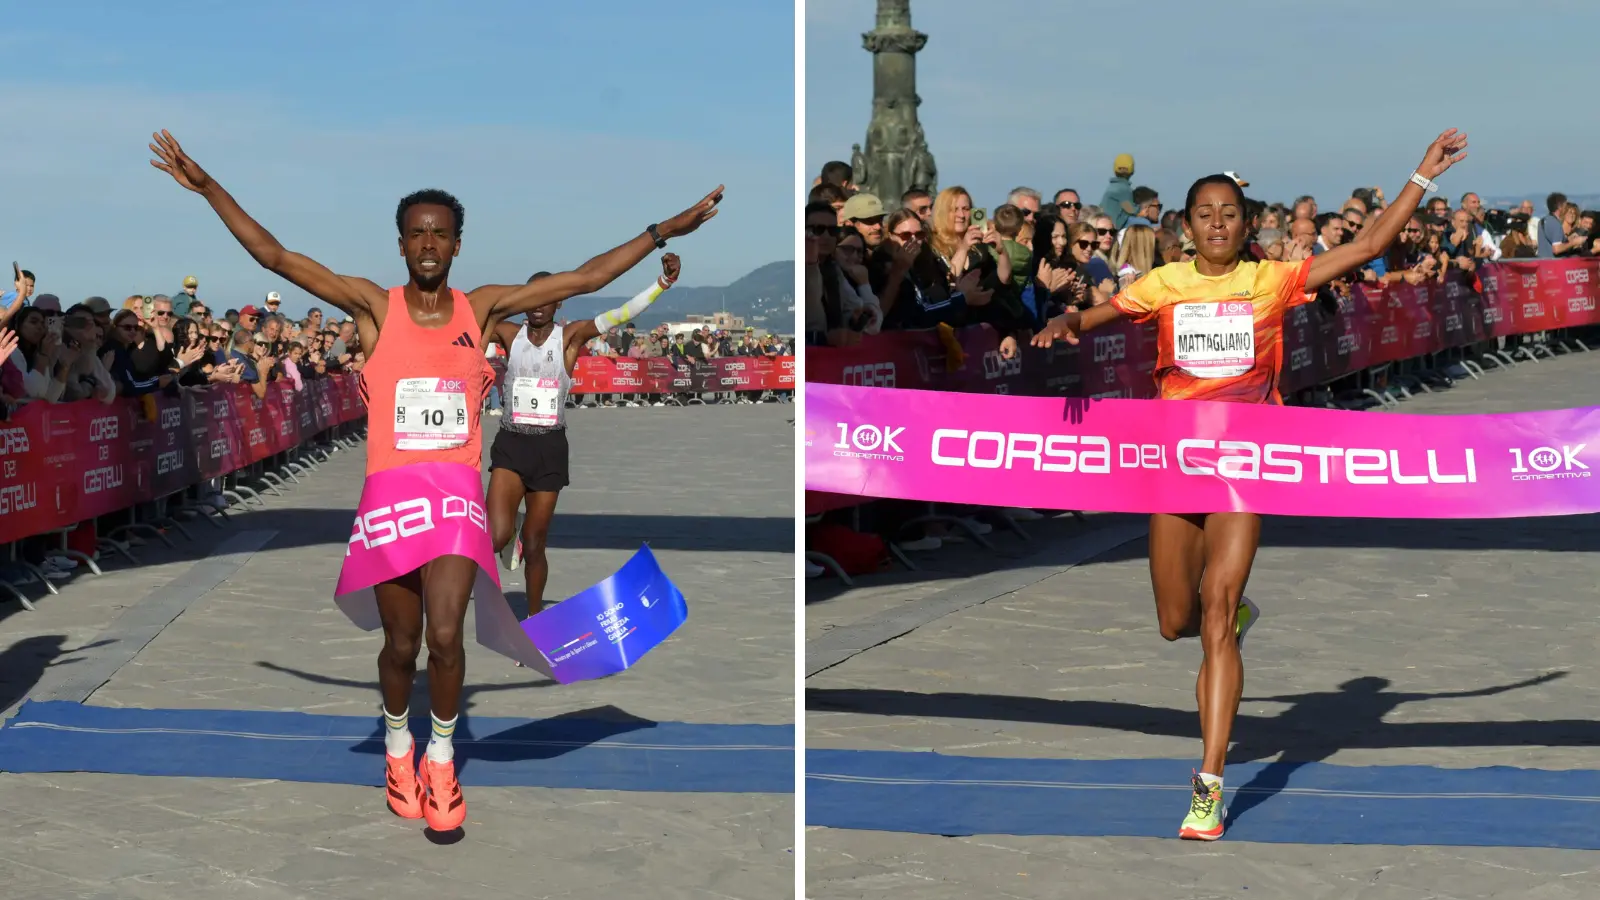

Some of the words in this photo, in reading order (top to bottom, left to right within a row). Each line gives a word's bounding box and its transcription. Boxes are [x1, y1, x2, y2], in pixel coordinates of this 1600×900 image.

[1222, 303, 1248, 313] 10K
[1094, 334, 1126, 362] CORSA
[1178, 332, 1251, 353] MATTAGLIANO
[441, 380, 462, 390] 10K
[612, 377, 643, 386] CASTELLI
[720, 377, 751, 386] CASTELLI
[530, 398, 539, 410] 9
[420, 409, 445, 427] 10
[90, 416, 119, 442] CORSA
[834, 422, 906, 453] 10K
[833, 450, 904, 462] COMPETITIVA
[930, 428, 1111, 474] CORSA
[1119, 443, 1167, 469] DEI
[1176, 438, 1477, 485] CASTELLI
[1508, 443, 1590, 473] 10K
[84, 463, 123, 494] CASTELLI
[1512, 471, 1591, 481] COMPETITIVA
[442, 495, 488, 533] DEI
[596, 613, 604, 621] IO
[603, 616, 630, 634] VENEZIA
